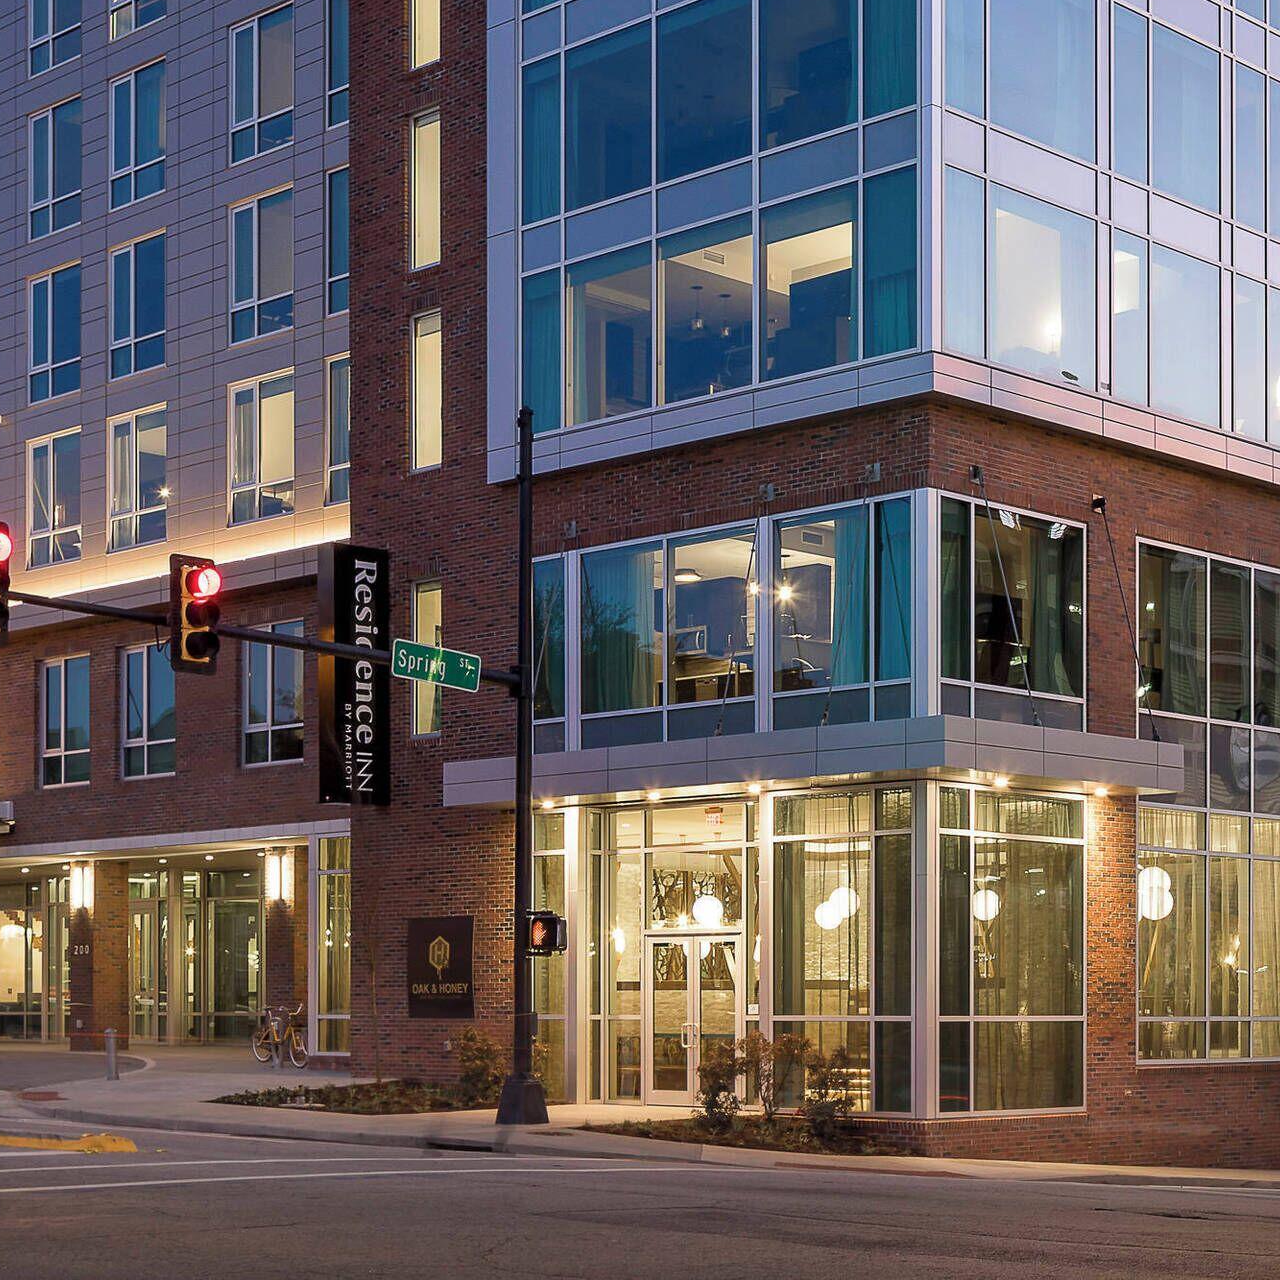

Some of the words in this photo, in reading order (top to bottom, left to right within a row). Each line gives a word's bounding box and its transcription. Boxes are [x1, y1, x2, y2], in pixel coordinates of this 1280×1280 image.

[398, 648, 446, 682] Spring
[344, 703, 352, 719] BY
[344, 723, 353, 790] MARRIOTT
[356, 751, 374, 793] INN
[74, 945, 90, 955] 200
[412, 983, 430, 994] OAK
[431, 983, 438, 994] &
[439, 982, 469, 994] HONEY
